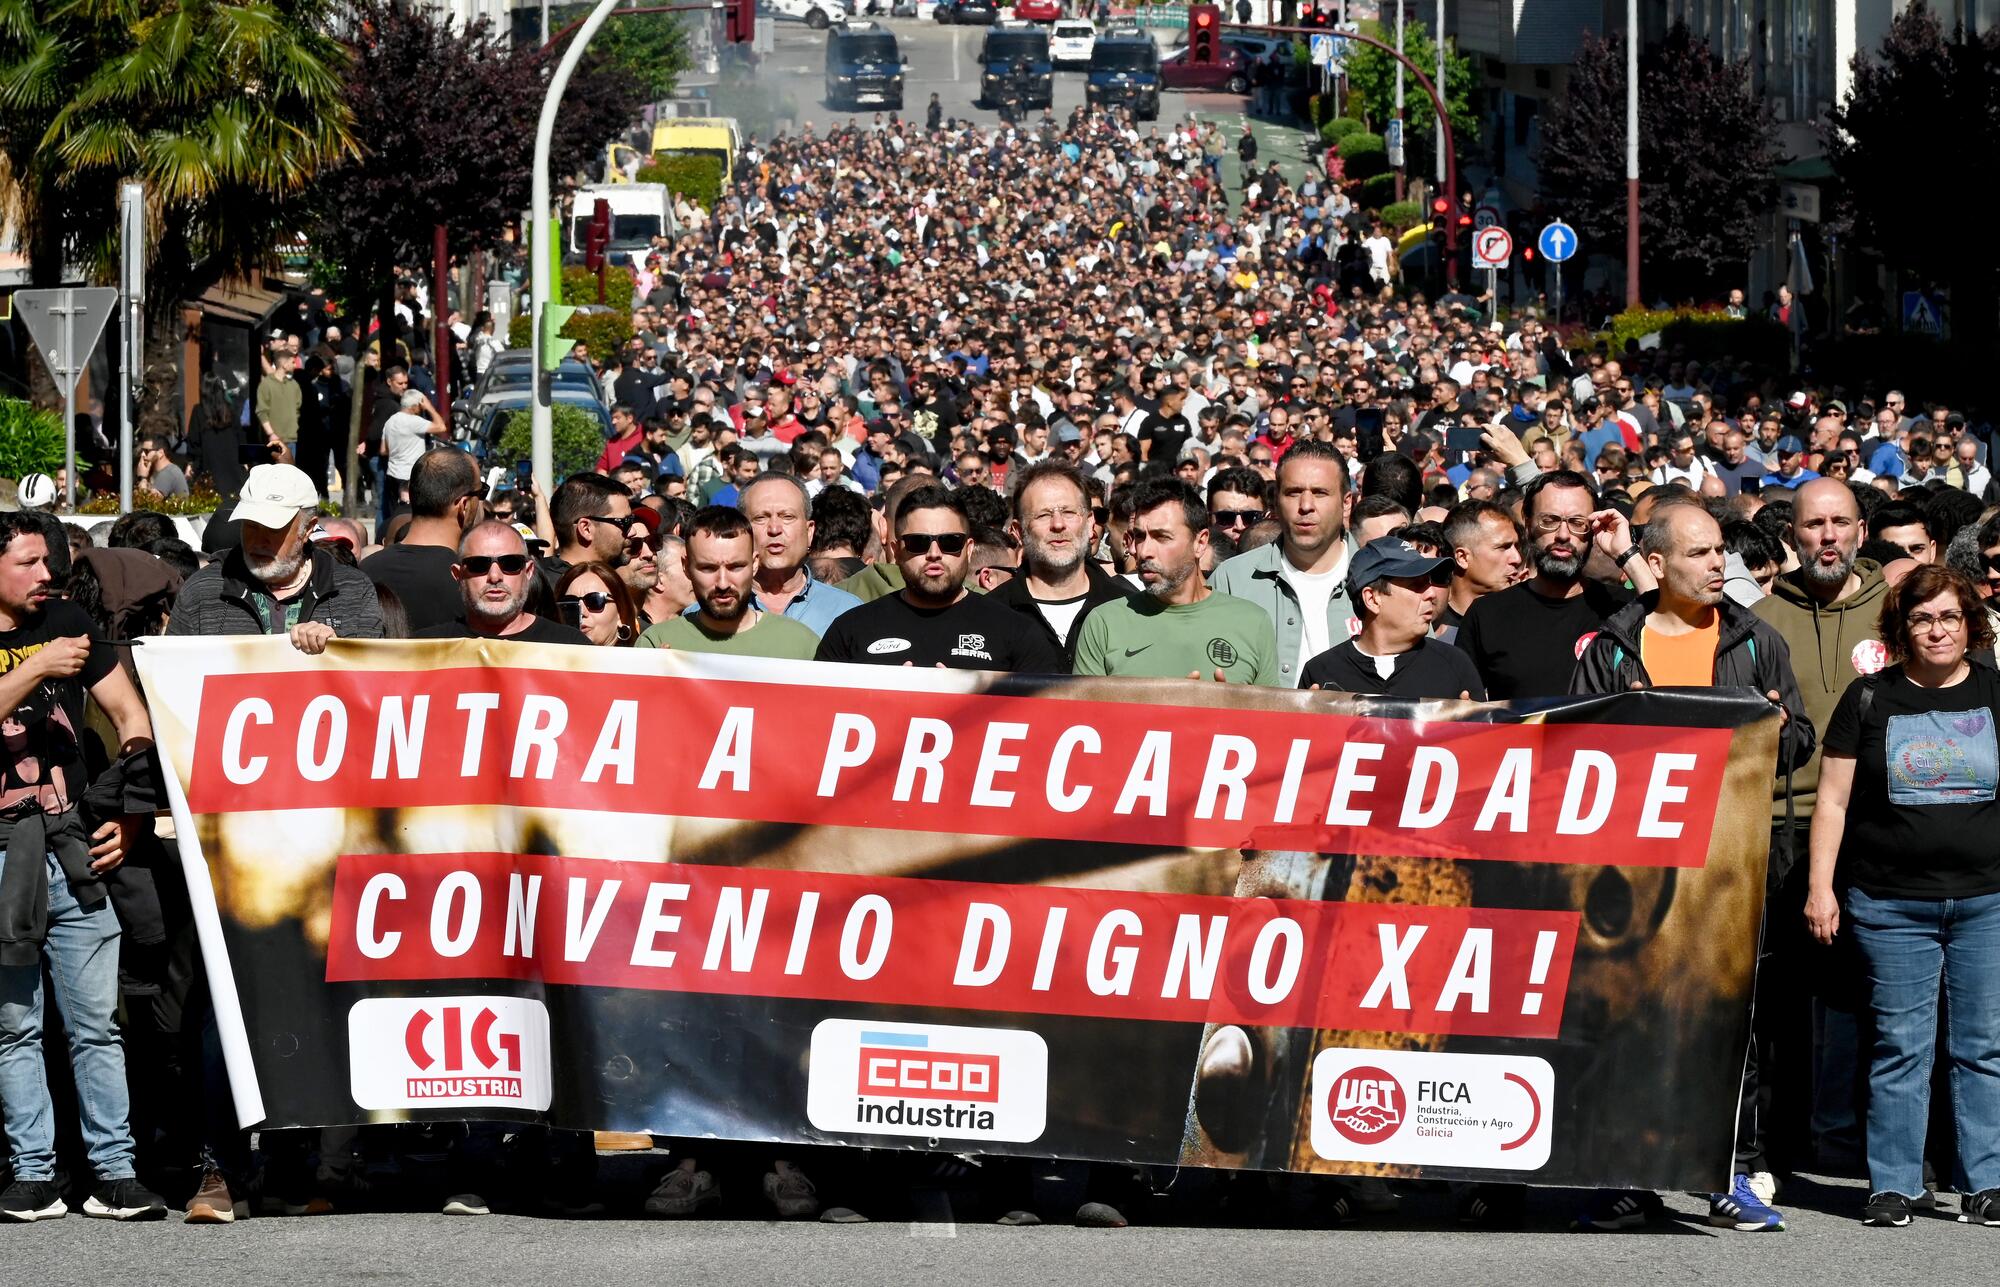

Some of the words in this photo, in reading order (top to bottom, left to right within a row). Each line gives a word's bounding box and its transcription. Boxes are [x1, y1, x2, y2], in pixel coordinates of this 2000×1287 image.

[1478, 215, 1494, 226] 30
[875, 640, 901, 651] Ford
[950, 648, 992, 661] SIERRA
[222, 693, 638, 784] CONTRA
[698, 707, 754, 791] A
[817, 713, 1697, 838] PRECARIEDADE
[356, 871, 893, 980] CONVENIO
[953, 903, 1303, 1004] DIGNO
[1359, 924, 1557, 1014] XA!
[405, 1007, 521, 1072] CIG
[867, 1057, 990, 1093] CCOO
[409, 1079, 520, 1096] INDUSTRIA
[1337, 1078, 1397, 1110] UGT
[1418, 1081, 1471, 1103] FICA
[857, 1098, 994, 1130] industria
[1417, 1105, 1462, 1116] Industria,
[1416, 1126, 1453, 1138] Galicia
[1417, 1115, 1479, 1127] Construcción
[1482, 1120, 1487, 1129] y
[1491, 1118, 1513, 1130] Agro
